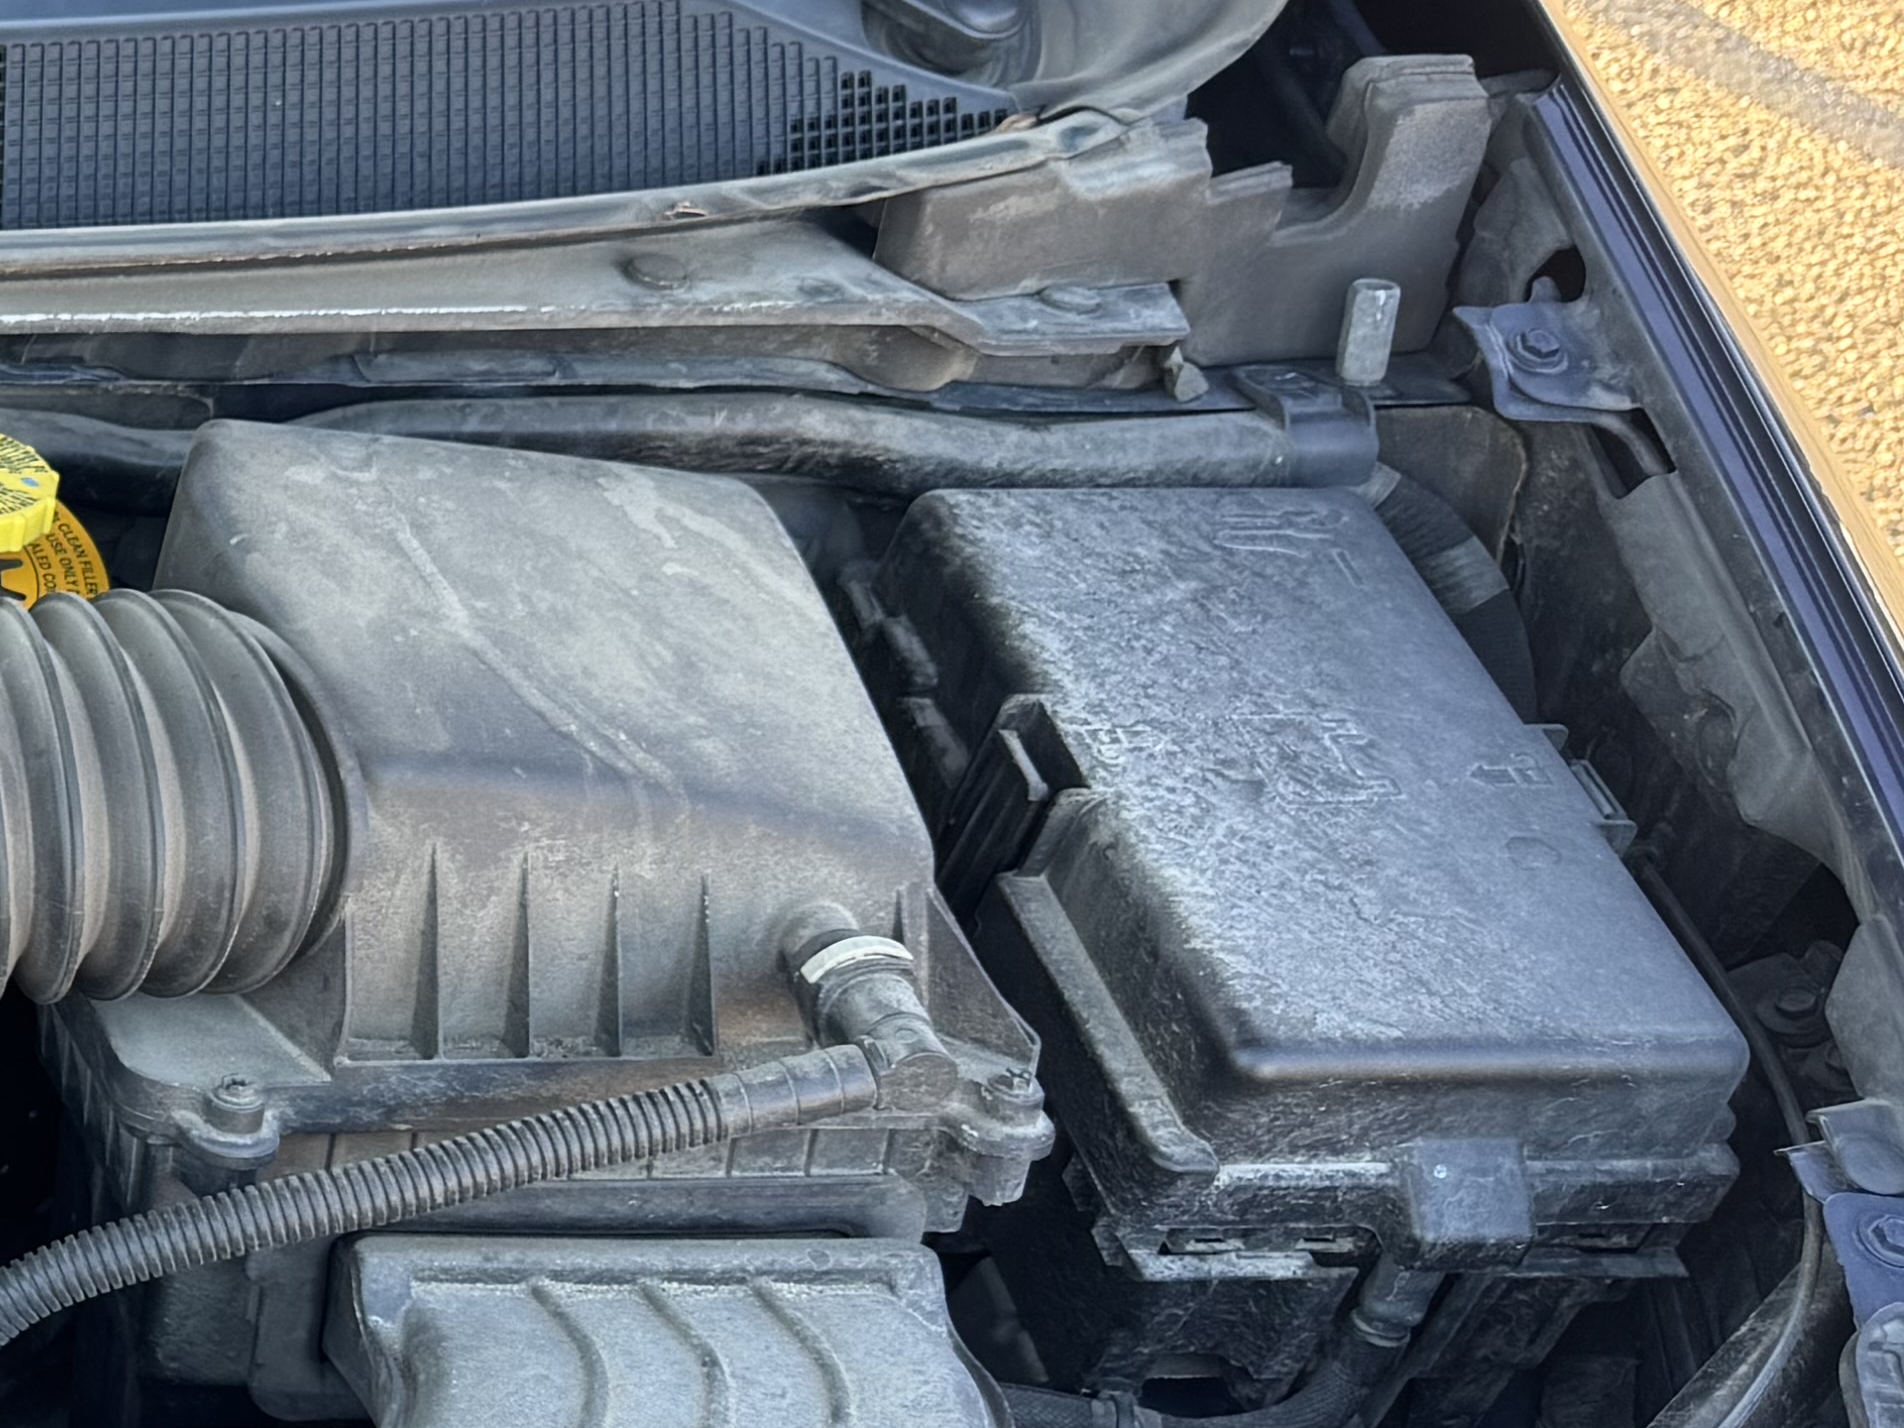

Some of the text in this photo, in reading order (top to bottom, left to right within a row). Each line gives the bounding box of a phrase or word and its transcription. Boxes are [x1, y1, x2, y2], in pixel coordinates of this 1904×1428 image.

[27, 543, 51, 570] ALED
[45, 533, 67, 555] USE
[59, 558, 79, 586] ONLY
[59, 523, 98, 595] CLEAN FILLER
